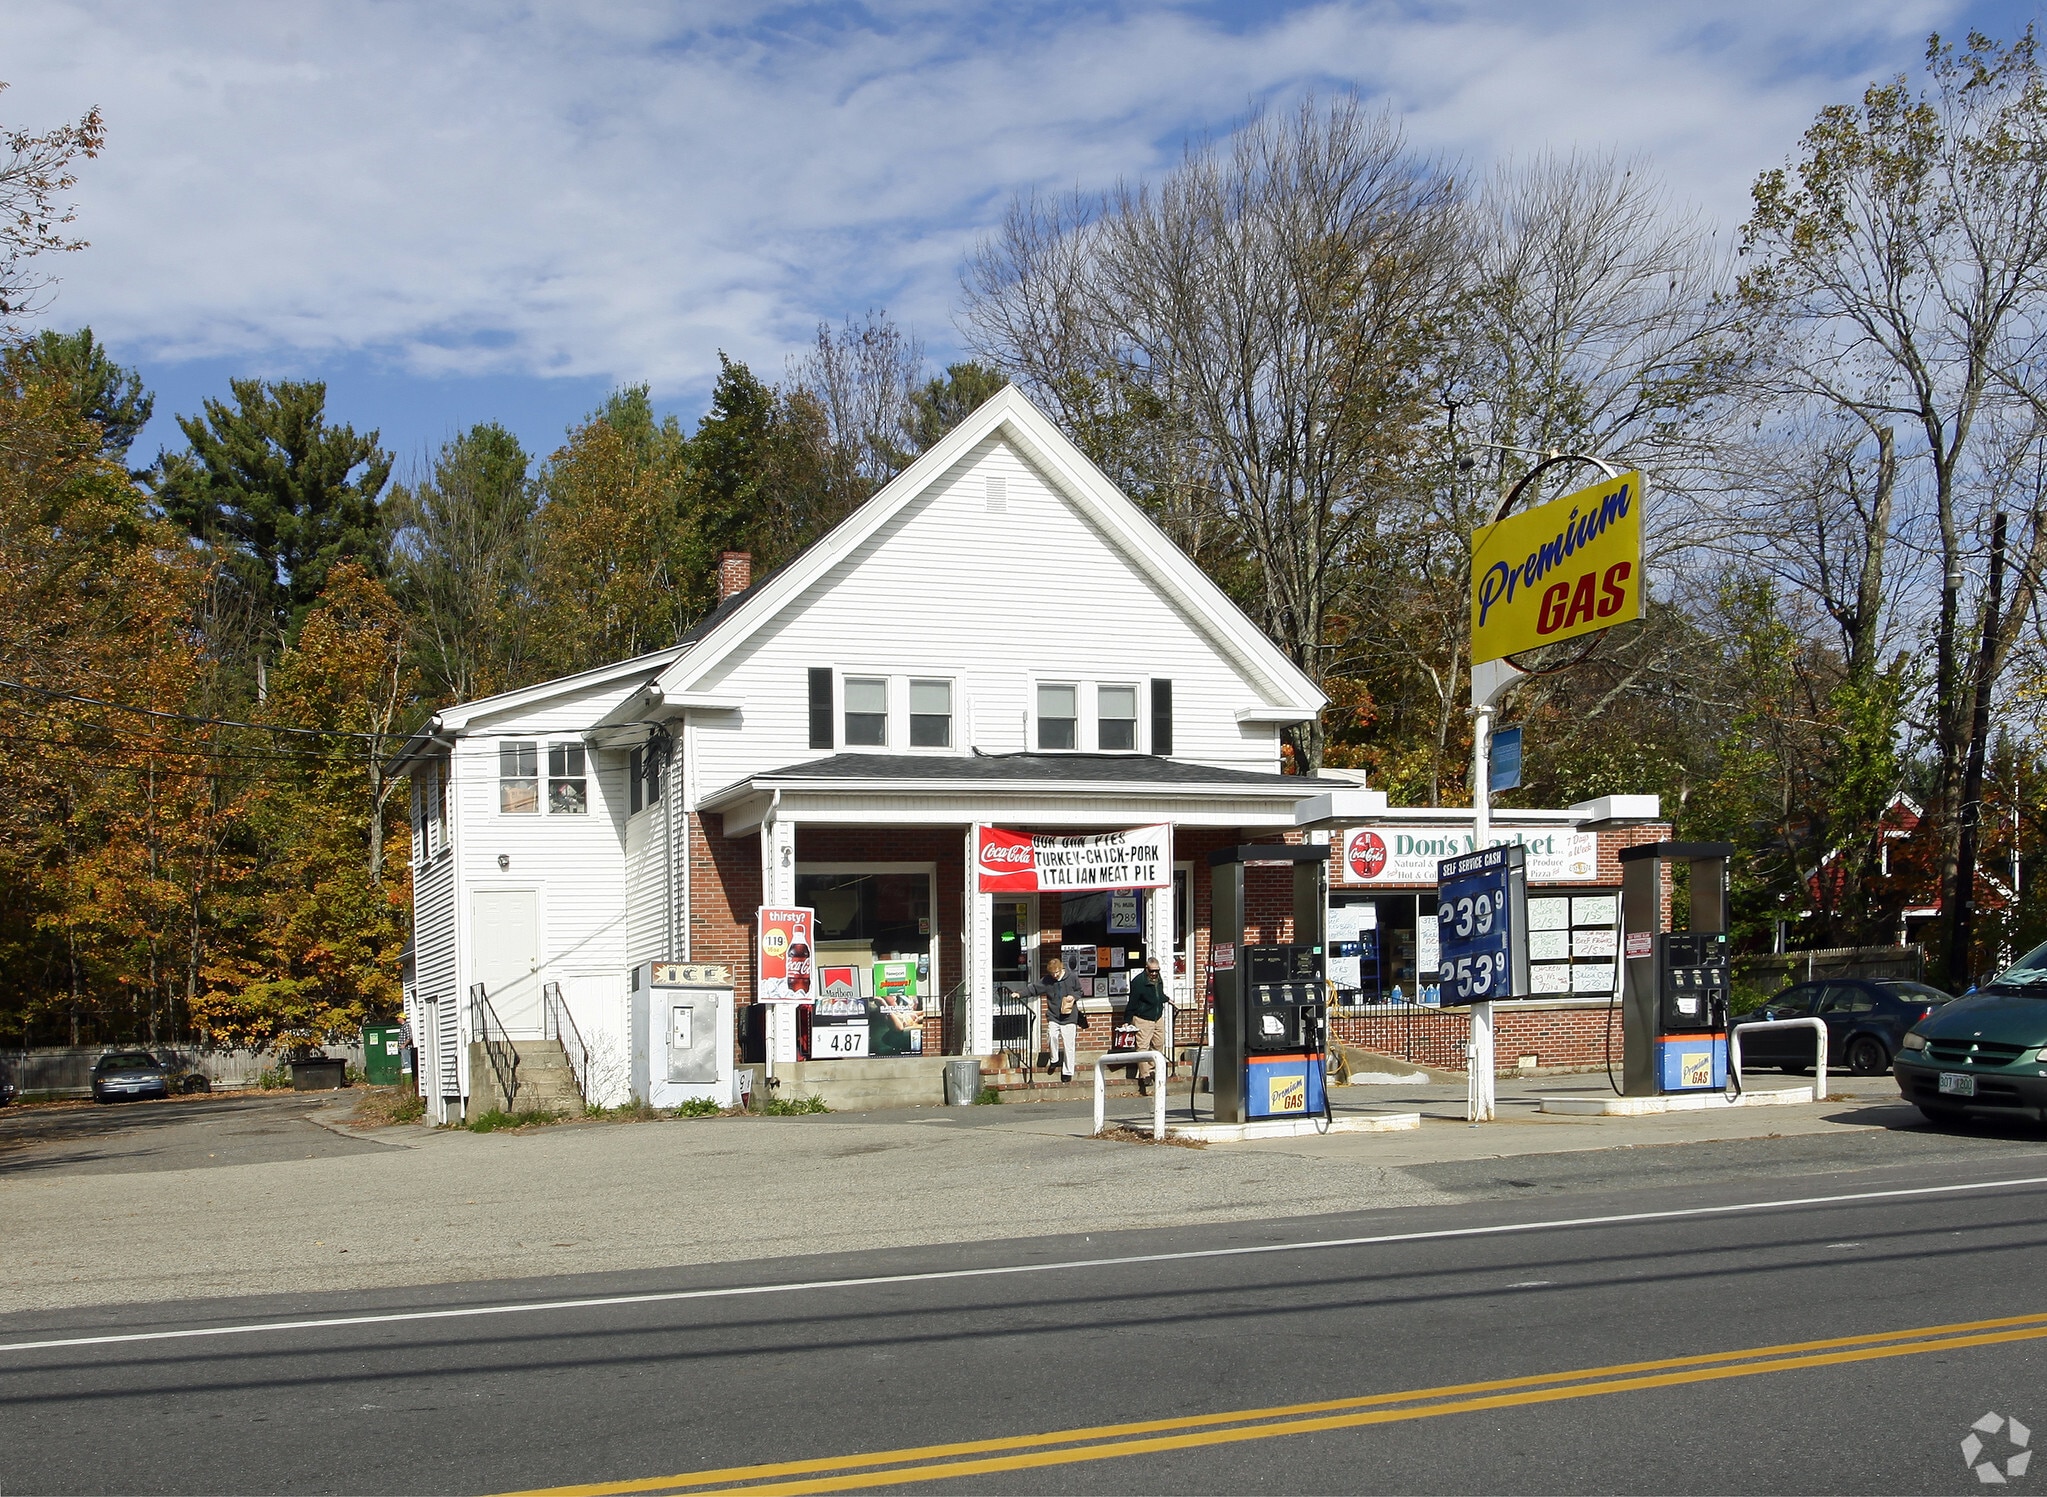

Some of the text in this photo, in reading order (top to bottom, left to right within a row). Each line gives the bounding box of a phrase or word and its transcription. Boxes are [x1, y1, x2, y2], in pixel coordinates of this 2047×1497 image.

[1479, 484, 1634, 628] Premium
[1536, 561, 1632, 635] GAS
[1095, 832, 1126, 847] PIES
[1394, 834, 1458, 856] Don's
[1573, 834, 1590, 845] Days
[981, 842, 1033, 864] Coca-Cola
[1394, 859, 1434, 868] Natural &
[1442, 850, 1502, 877] SELF SERVICE CASH
[1532, 858, 1564, 867] Produce
[1043, 865, 1156, 885] ITALIAN MEAT PIE
[1398, 871, 1413, 879] Hot
[1425, 871, 1438, 879] Col
[1530, 870, 1551, 878] Pizza
[769, 911, 806, 923] thirsty?
[668, 966, 719, 982] ICE
[825, 986, 854, 998] Marlboro
[831, 1034, 862, 1052] 4.87
[1691, 1071, 1709, 1084] GAS
[1271, 1079, 1303, 1106] Premium
[1284, 1093, 1303, 1109] GAS
